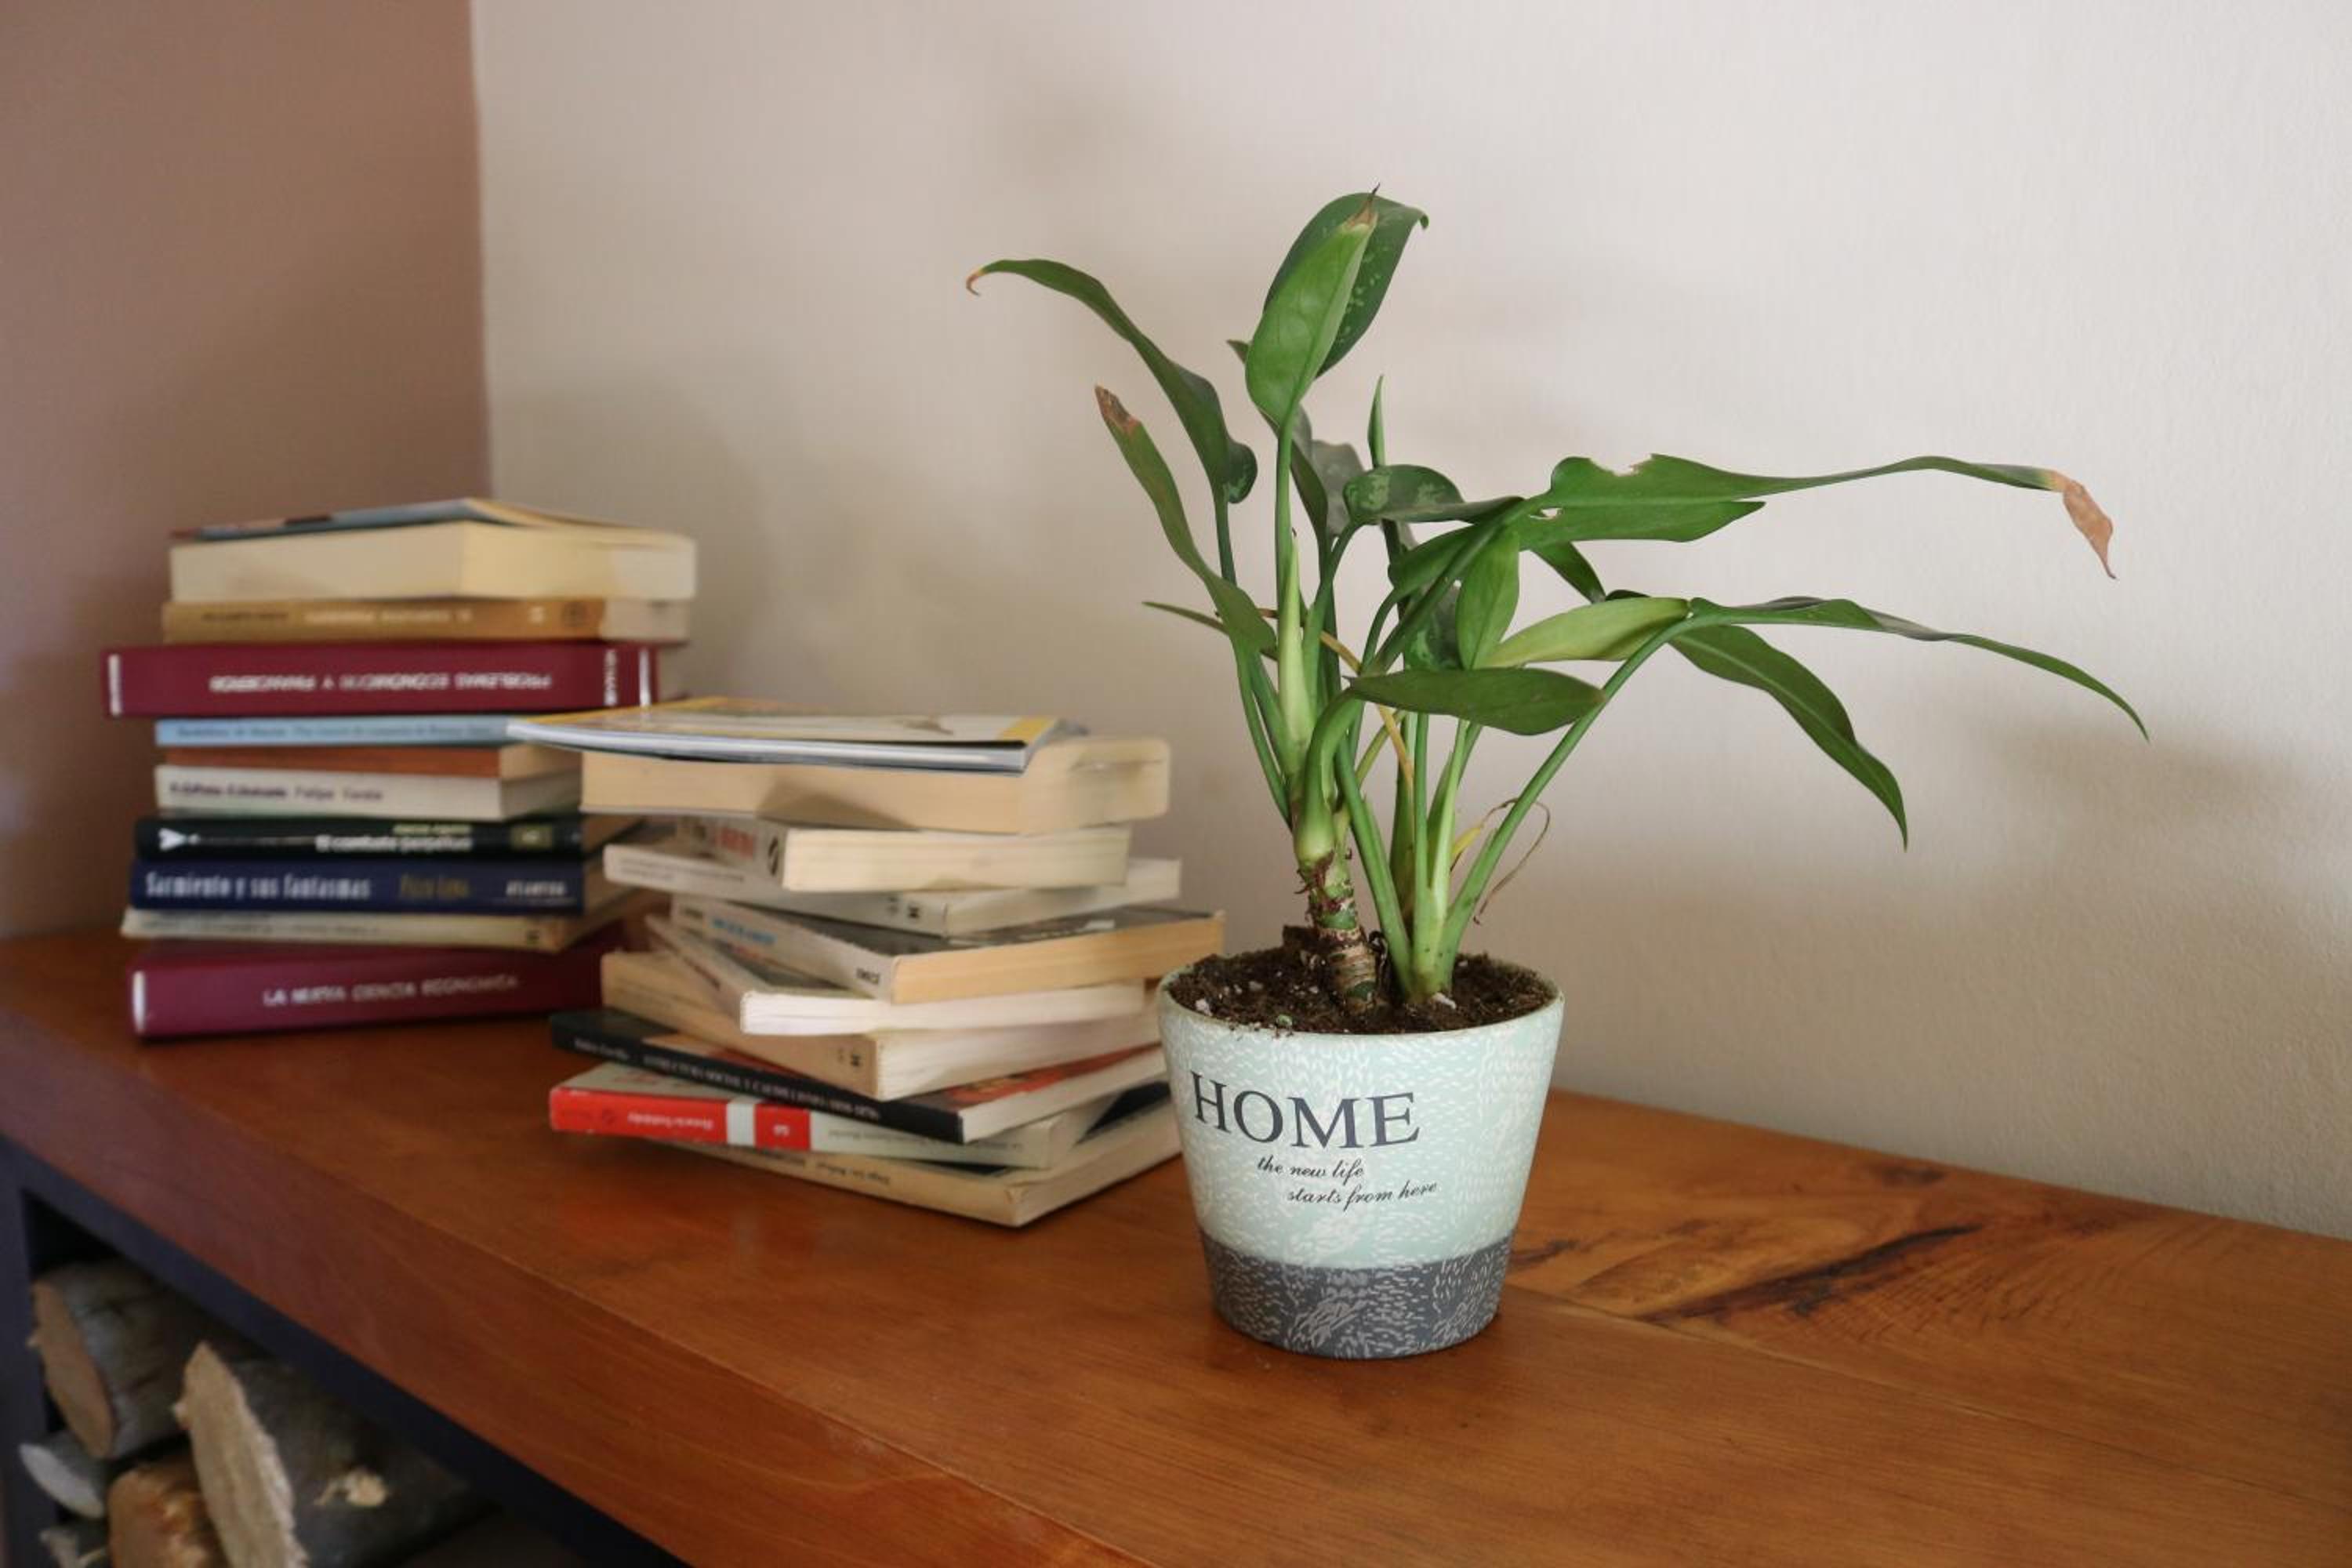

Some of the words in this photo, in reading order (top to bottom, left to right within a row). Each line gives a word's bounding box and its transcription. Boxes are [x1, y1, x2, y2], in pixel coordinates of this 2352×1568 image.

[146, 871, 231, 898] Sarmiento
[263, 988, 287, 1007] LA
[1189, 1069, 1421, 1149] HOME
[1257, 1154, 1284, 1175] the
[1290, 1166, 1327, 1178] new
[1332, 1158, 1365, 1186] life
[1287, 1187, 1341, 1203] starts
[1343, 1185, 1394, 1212] from
[1398, 1179, 1438, 1200] here
